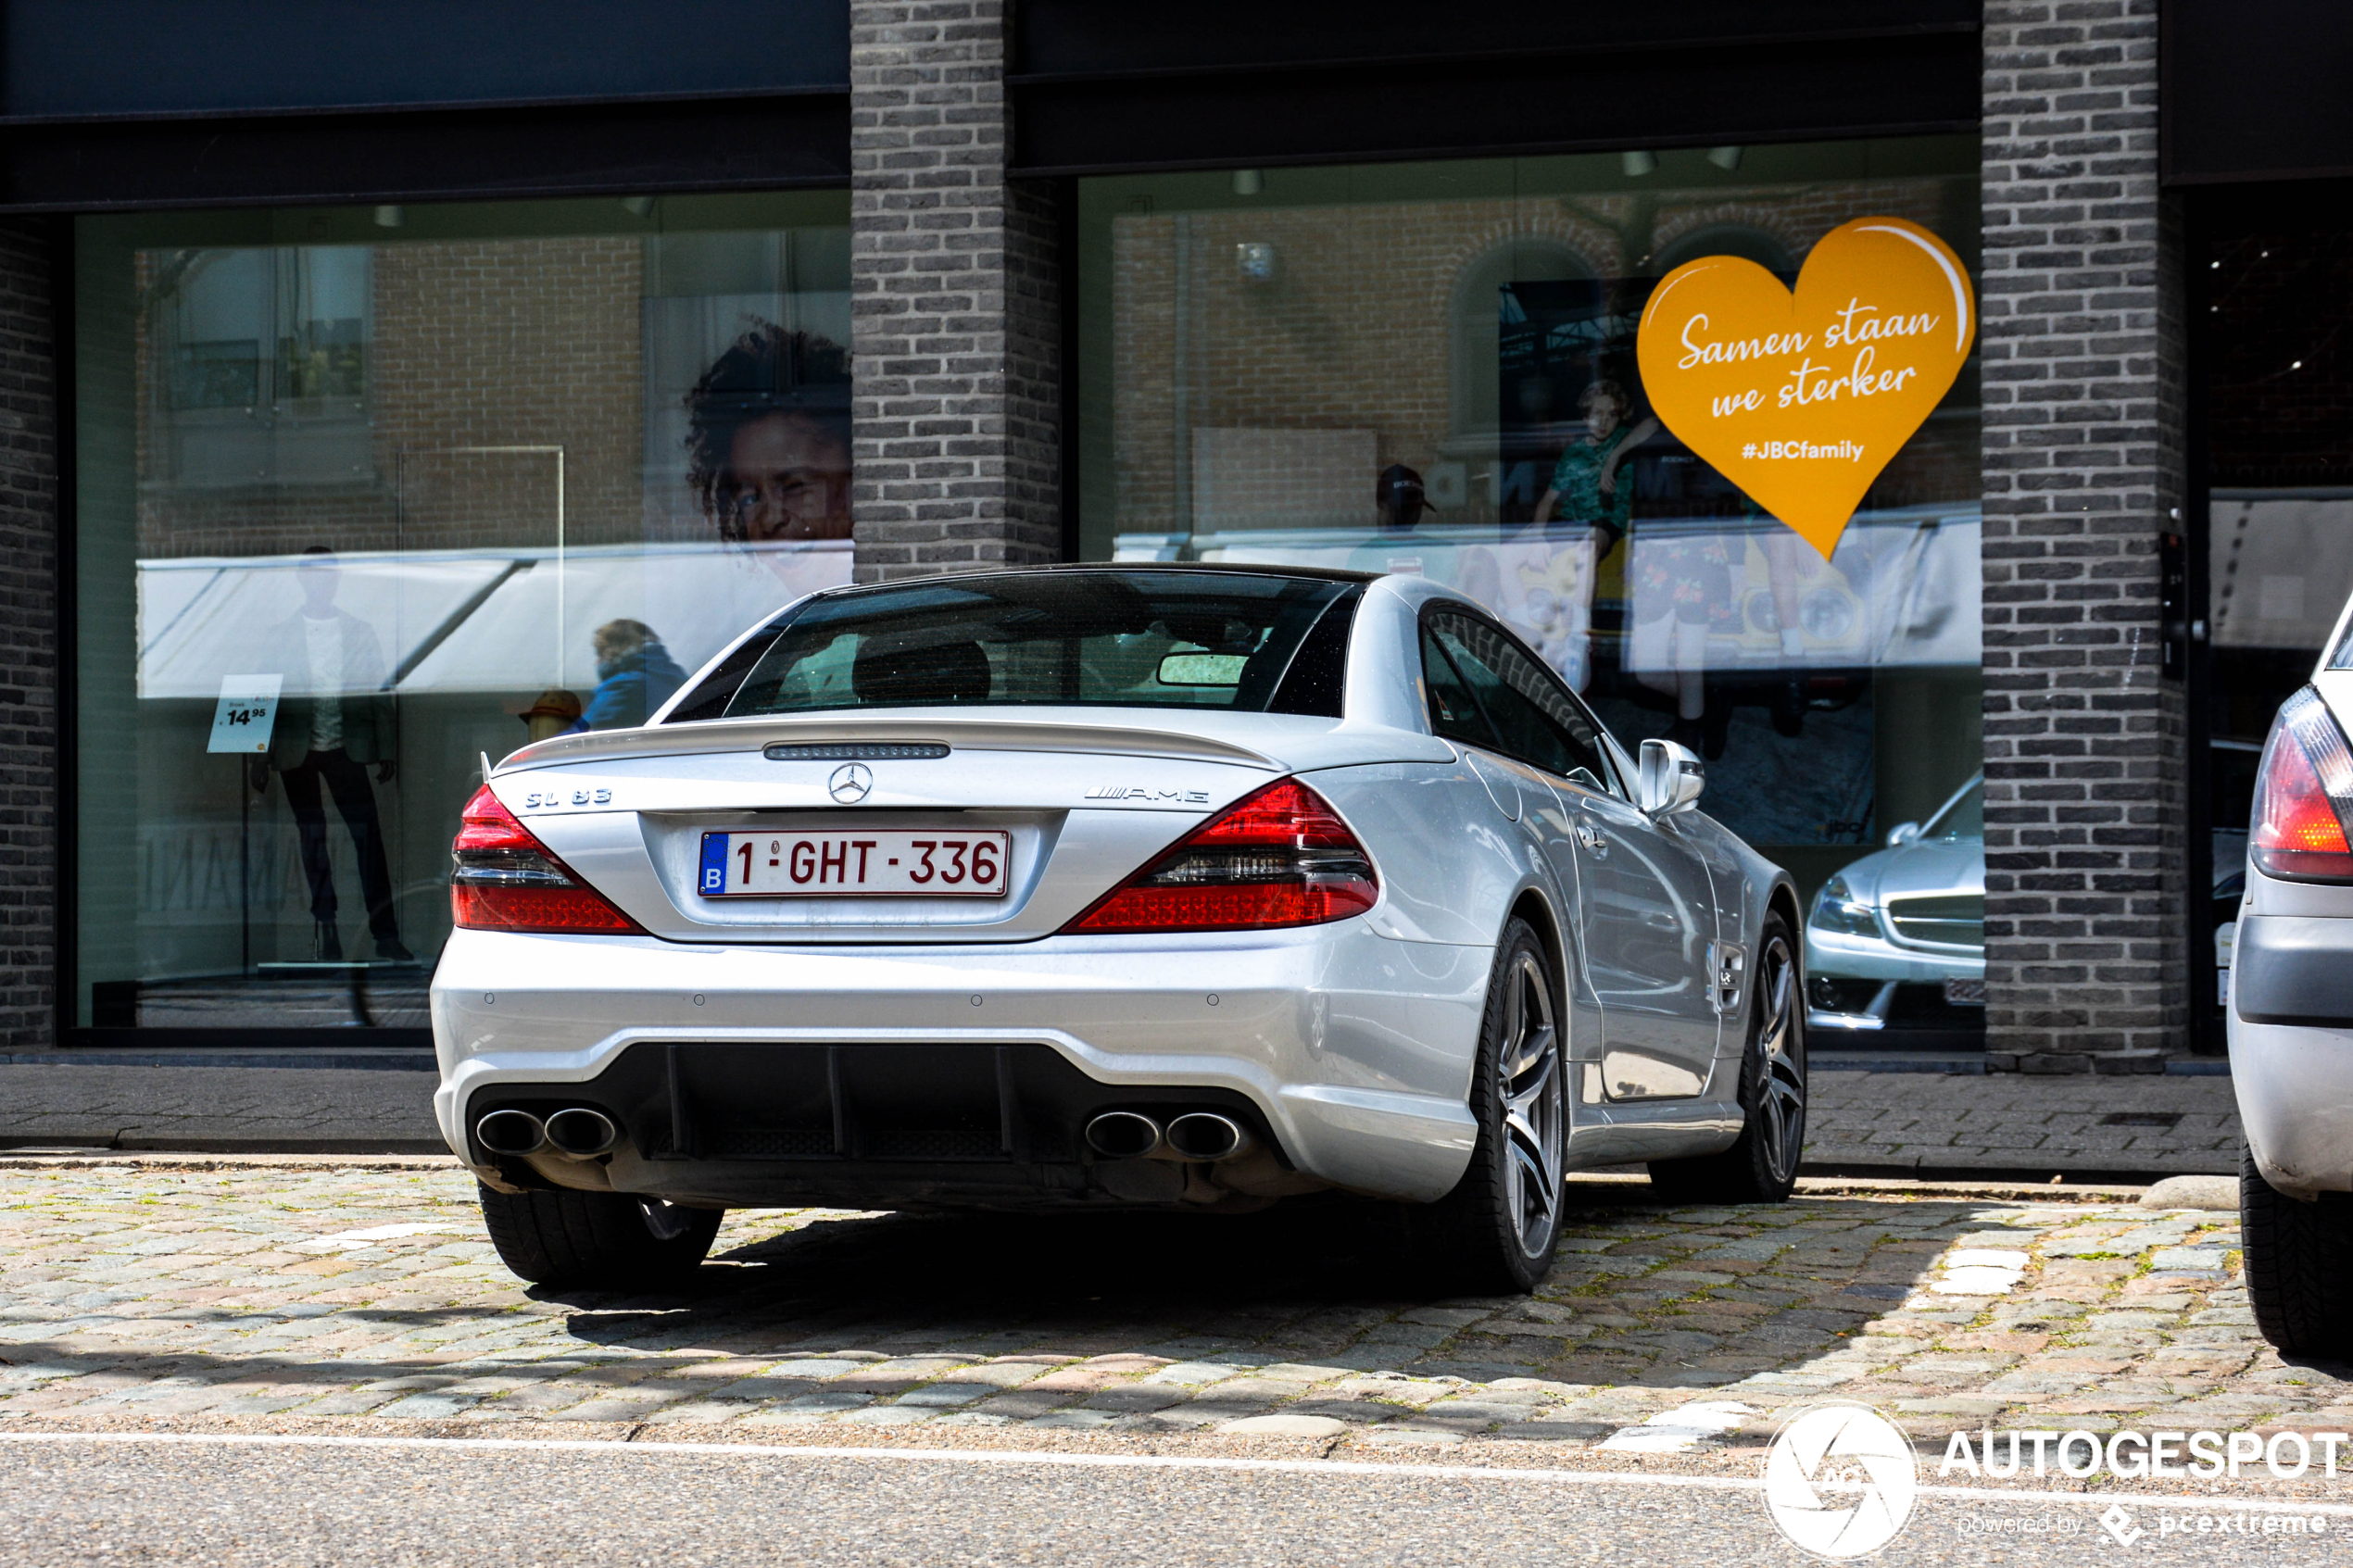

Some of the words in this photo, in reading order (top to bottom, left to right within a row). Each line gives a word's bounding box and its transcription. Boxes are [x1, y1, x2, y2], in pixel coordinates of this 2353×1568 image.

[1678, 313, 1813, 370] Samen
[1825, 297, 1940, 348] staan
[1712, 389, 1766, 418] we
[1778, 345, 1917, 408] sterker
[1741, 440, 1865, 462] #JBCfamily
[525, 792, 559, 811] SL
[1122, 786, 1209, 803] AMG
[704, 868, 723, 889] B
